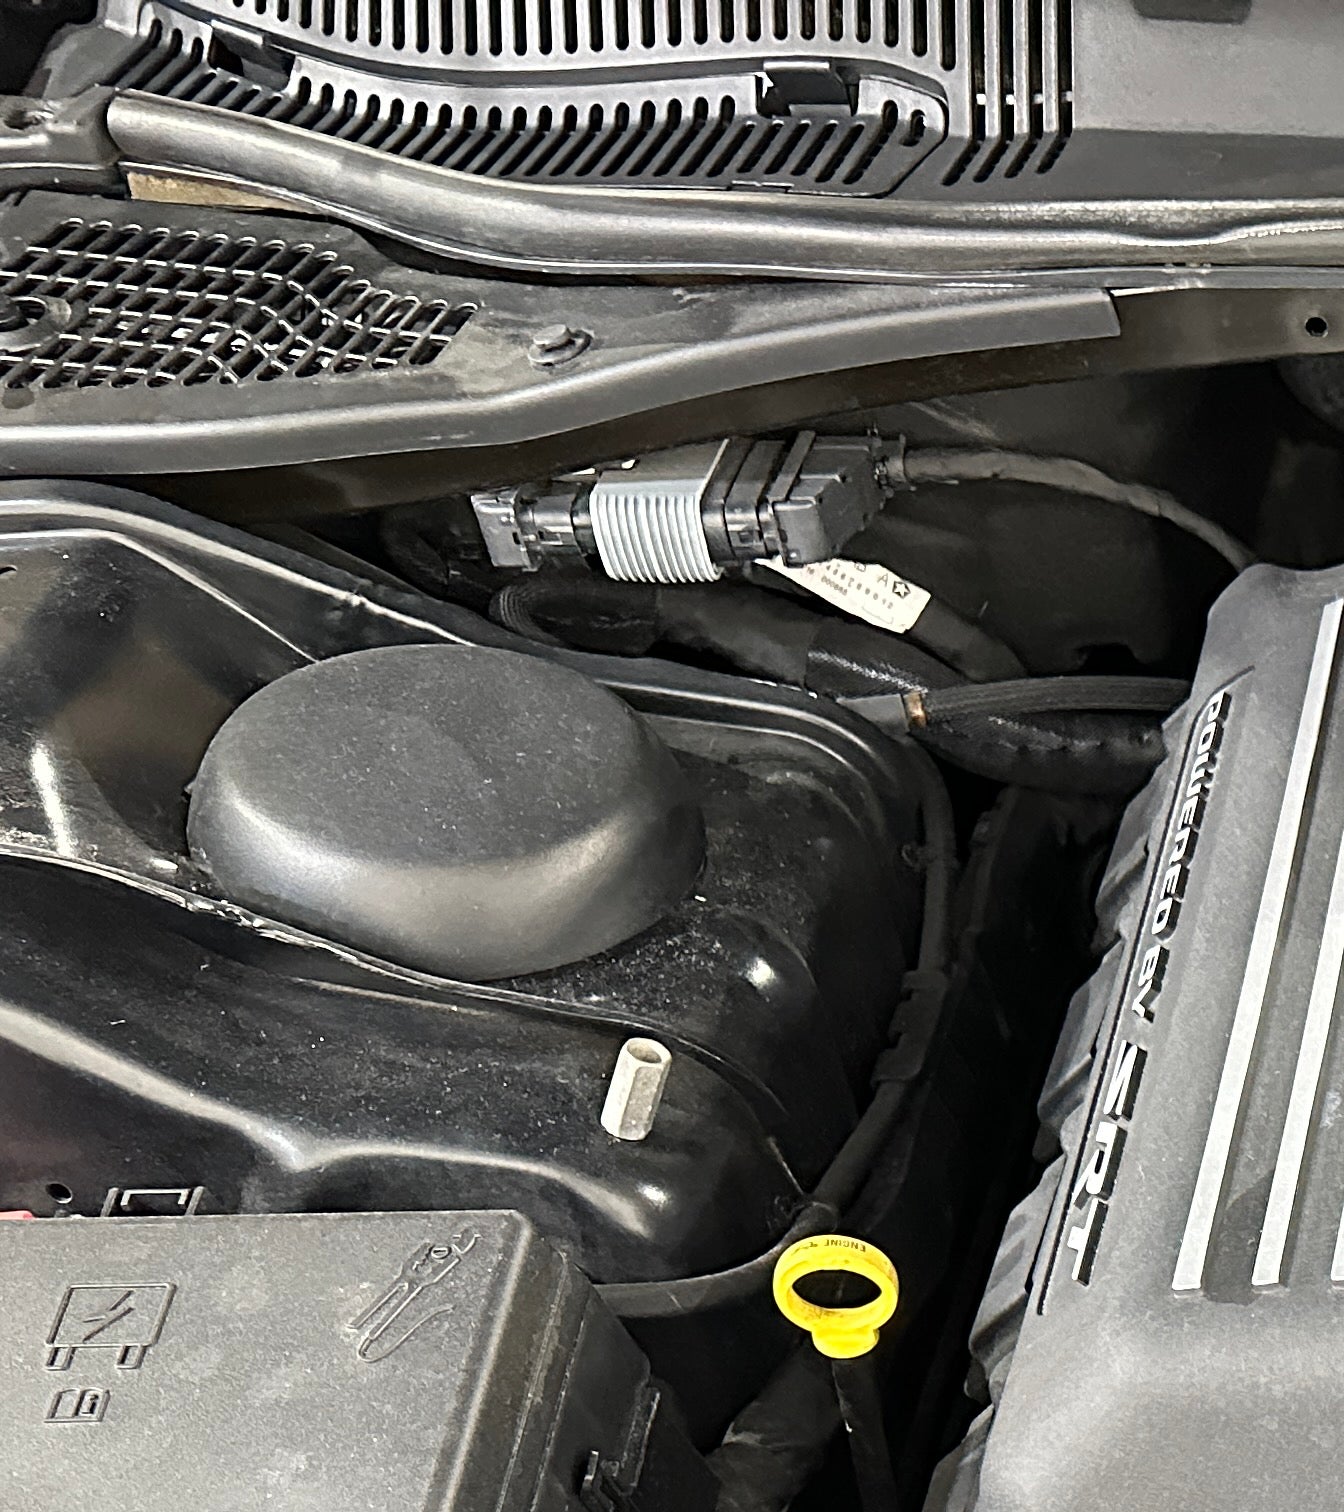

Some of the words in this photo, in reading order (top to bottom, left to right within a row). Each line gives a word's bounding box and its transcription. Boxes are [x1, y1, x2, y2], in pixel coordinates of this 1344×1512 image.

[1152, 690, 1230, 936] POWERED
[1132, 945, 1167, 1018] BY
[1067, 1039, 1140, 1282] SRT
